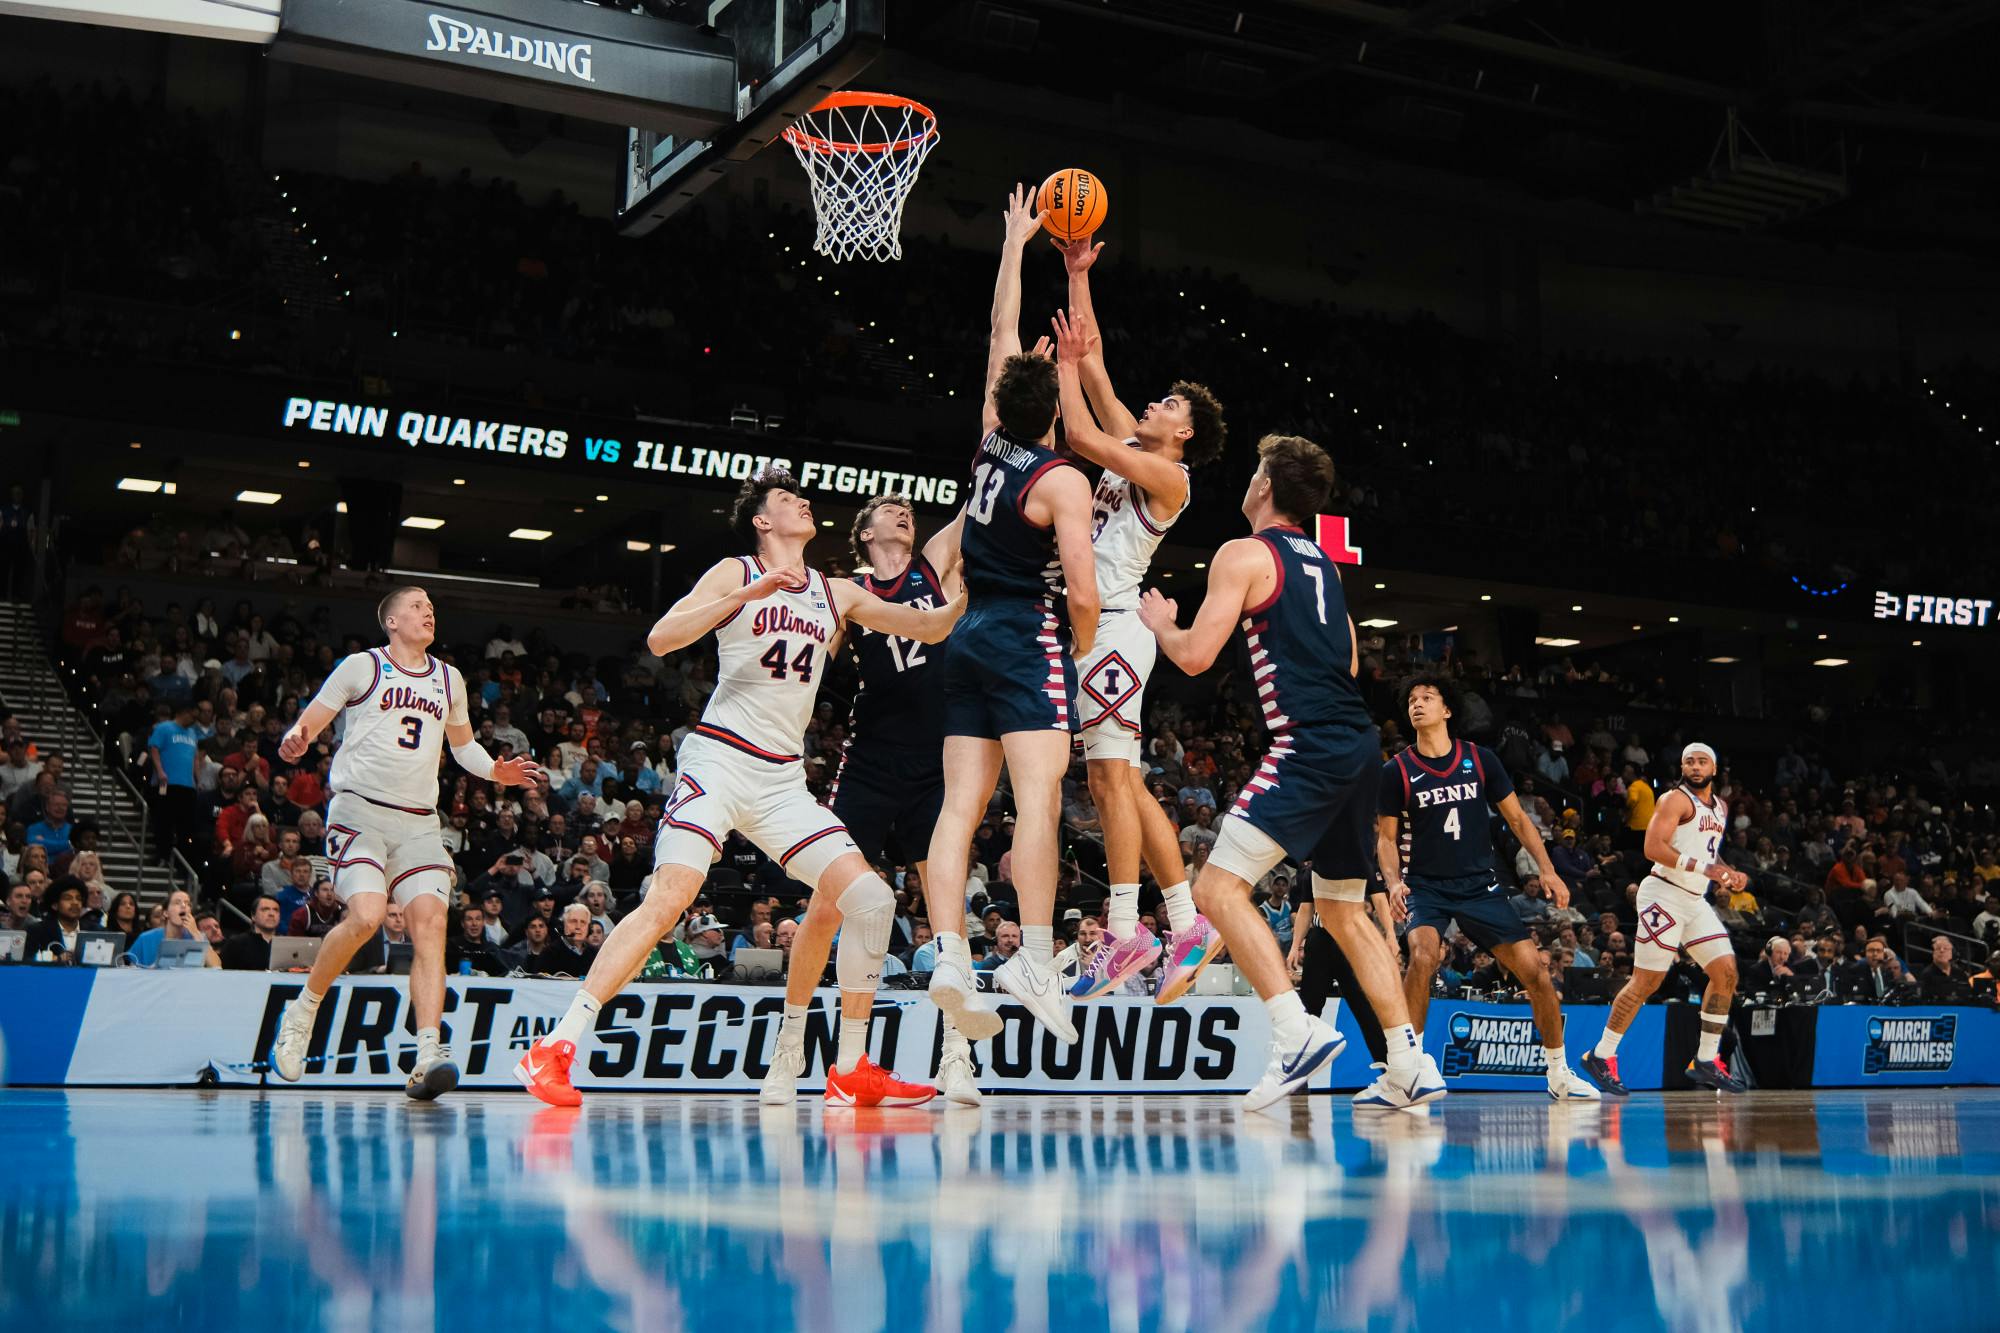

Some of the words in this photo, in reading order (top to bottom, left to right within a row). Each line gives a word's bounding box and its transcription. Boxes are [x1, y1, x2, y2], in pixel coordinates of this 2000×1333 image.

[427, 14, 595, 82] SPALDING
[1054, 177, 1065, 209] NCAA
[1075, 174, 1090, 216] Wilson
[284, 397, 388, 437] PENN
[398, 411, 569, 459] QUAKERS
[584, 437, 622, 463] VS
[801, 461, 958, 505] FIGHTING
[967, 462, 1005, 526] 13
[1302, 563, 1327, 625] 7
[1905, 594, 1992, 626] FIRST
[752, 606, 826, 644] Illinois
[759, 638, 816, 684] 44
[886, 634, 927, 673] 12
[379, 686, 444, 721] Illinois
[397, 715, 423, 750] 3
[1415, 781, 1478, 808] PENN
[1443, 807, 1461, 841] 4
[1699, 815, 1723, 833] Illino
[1707, 836, 1716, 859] 4
[508, 1016, 563, 1050] AN
[1470, 1019, 1533, 1044] MARCH
[1882, 1021, 1932, 1042] MARCH
[1477, 1042, 1549, 1067] MADNES
[1888, 1042, 1954, 1063] MADNESS
